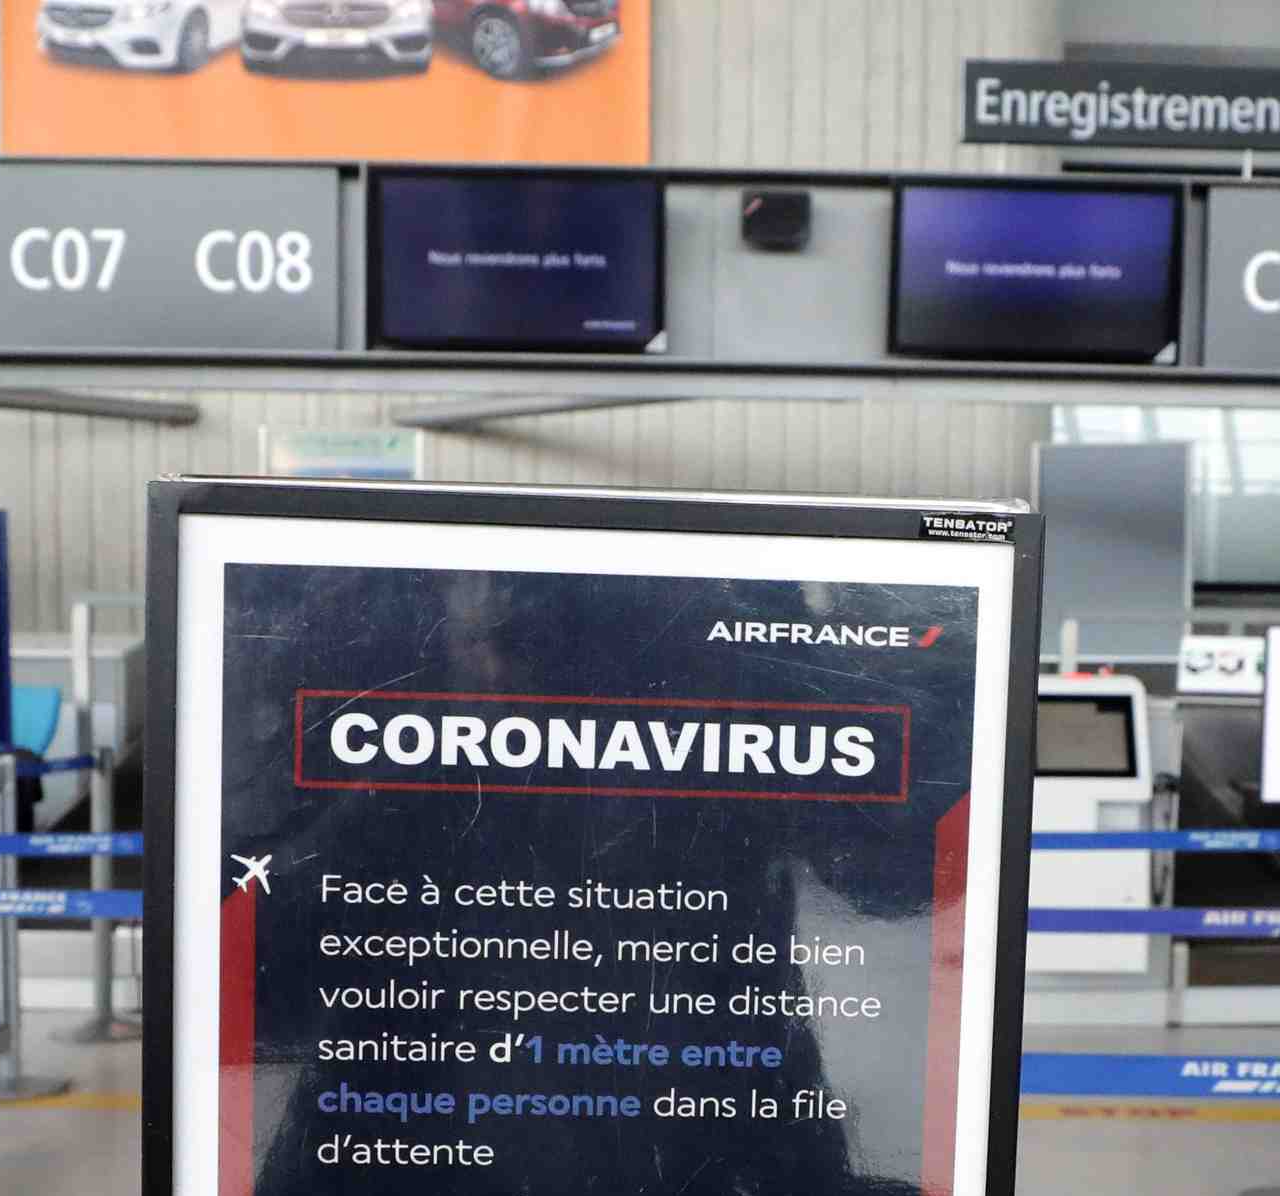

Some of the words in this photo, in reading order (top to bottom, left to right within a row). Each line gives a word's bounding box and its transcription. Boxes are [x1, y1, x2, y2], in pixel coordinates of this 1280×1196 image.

[10, 227, 127, 291] C07
[195, 229, 313, 293] C08
[707, 622, 909, 646] AIRFRANCE
[331, 713, 875, 776] CORONAVIRUS
[322, 875, 408, 904] Face
[421, 875, 439, 904] à
[455, 880, 555, 907] cette
[568, 881, 728, 911] situation
[1203, 910, 1247, 925] AIR
[320, 929, 602, 967] exceptionnelle,
[618, 934, 718, 962] merci
[732, 934, 776, 964] de
[791, 935, 864, 965] bien
[320, 979, 444, 1009] vouloir
[460, 987, 636, 1021] respecter
[650, 994, 715, 1014] une
[730, 986, 881, 1017] distance
[319, 1036, 476, 1062] sanitaire
[489, 1033, 542, 1063] d'1
[558, 1035, 669, 1065] mètre
[681, 1041, 782, 1067] entre
[1181, 1060, 1229, 1077] AIR
[318, 1085, 455, 1118] chaque
[469, 1094, 640, 1123] personne
[654, 1088, 736, 1117] dans
[752, 1089, 777, 1118] la
[792, 1090, 846, 1119] file
[319, 1137, 494, 1165] d'attente
